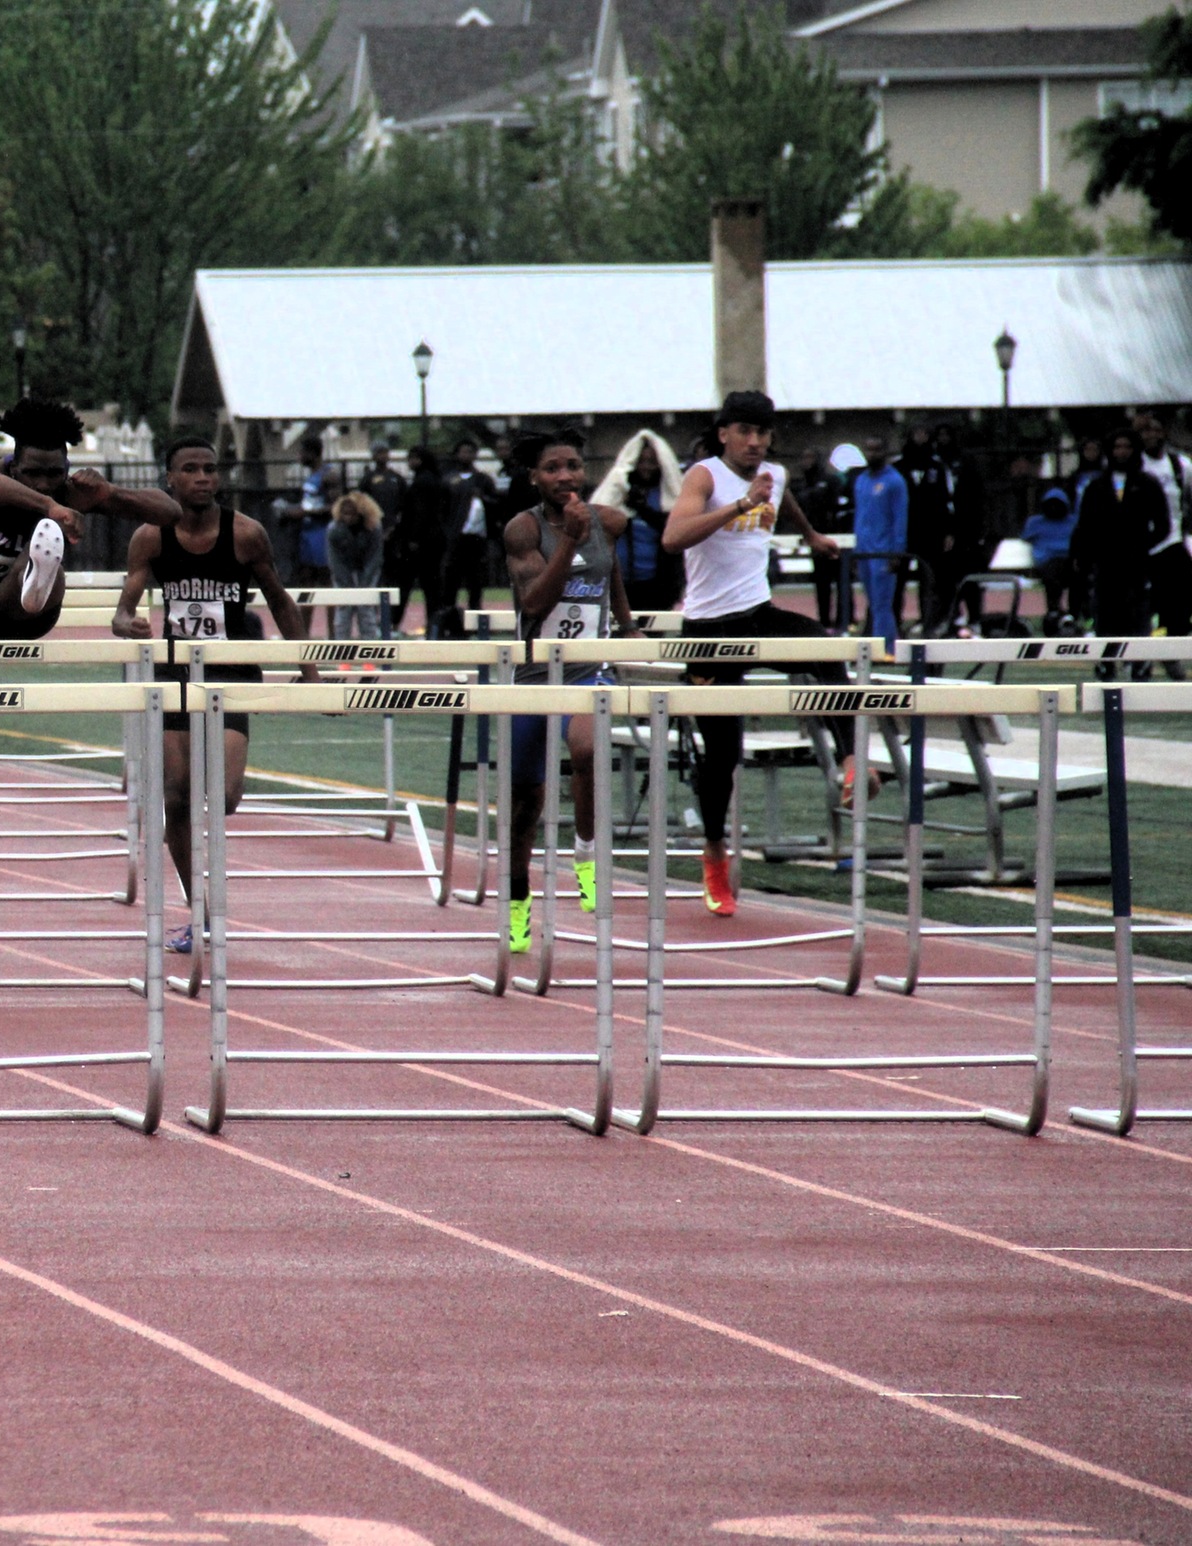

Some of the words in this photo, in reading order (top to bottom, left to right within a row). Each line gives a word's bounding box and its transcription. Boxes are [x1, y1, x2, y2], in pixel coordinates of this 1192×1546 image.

[177, 617, 217, 636] 179
[558, 619, 585, 638] 32
[2, 645, 40, 658] GILL
[358, 647, 396, 659] GILL
[718, 644, 756, 656] GILL
[1055, 644, 1090, 655] GILL
[417, 692, 465, 707] GILL
[864, 694, 912, 709] GILL
